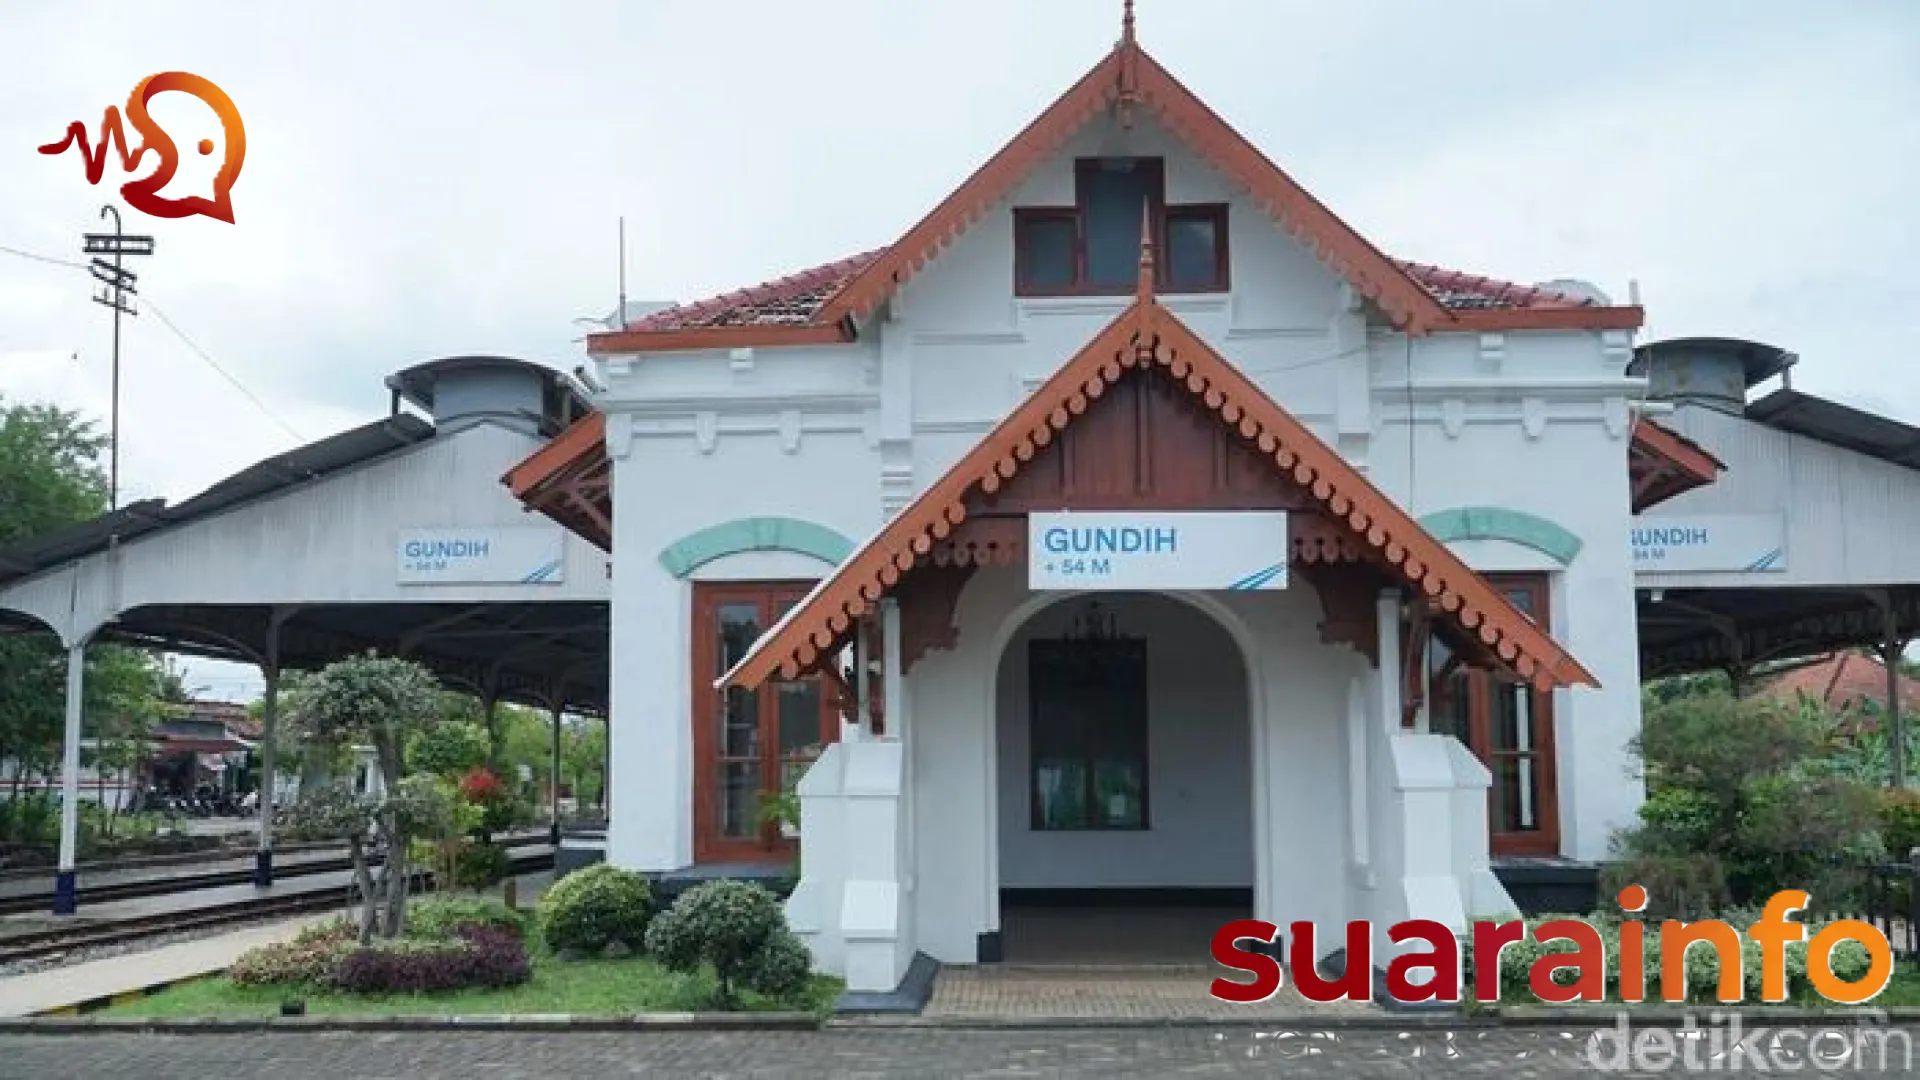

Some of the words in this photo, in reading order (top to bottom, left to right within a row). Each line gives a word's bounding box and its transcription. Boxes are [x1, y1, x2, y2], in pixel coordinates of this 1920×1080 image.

[405, 540, 490, 557] GUNDIH
[1044, 528, 1177, 553] GUNDIH
[1061, 558, 1085, 574] 54
[1091, 558, 1111, 574] M
